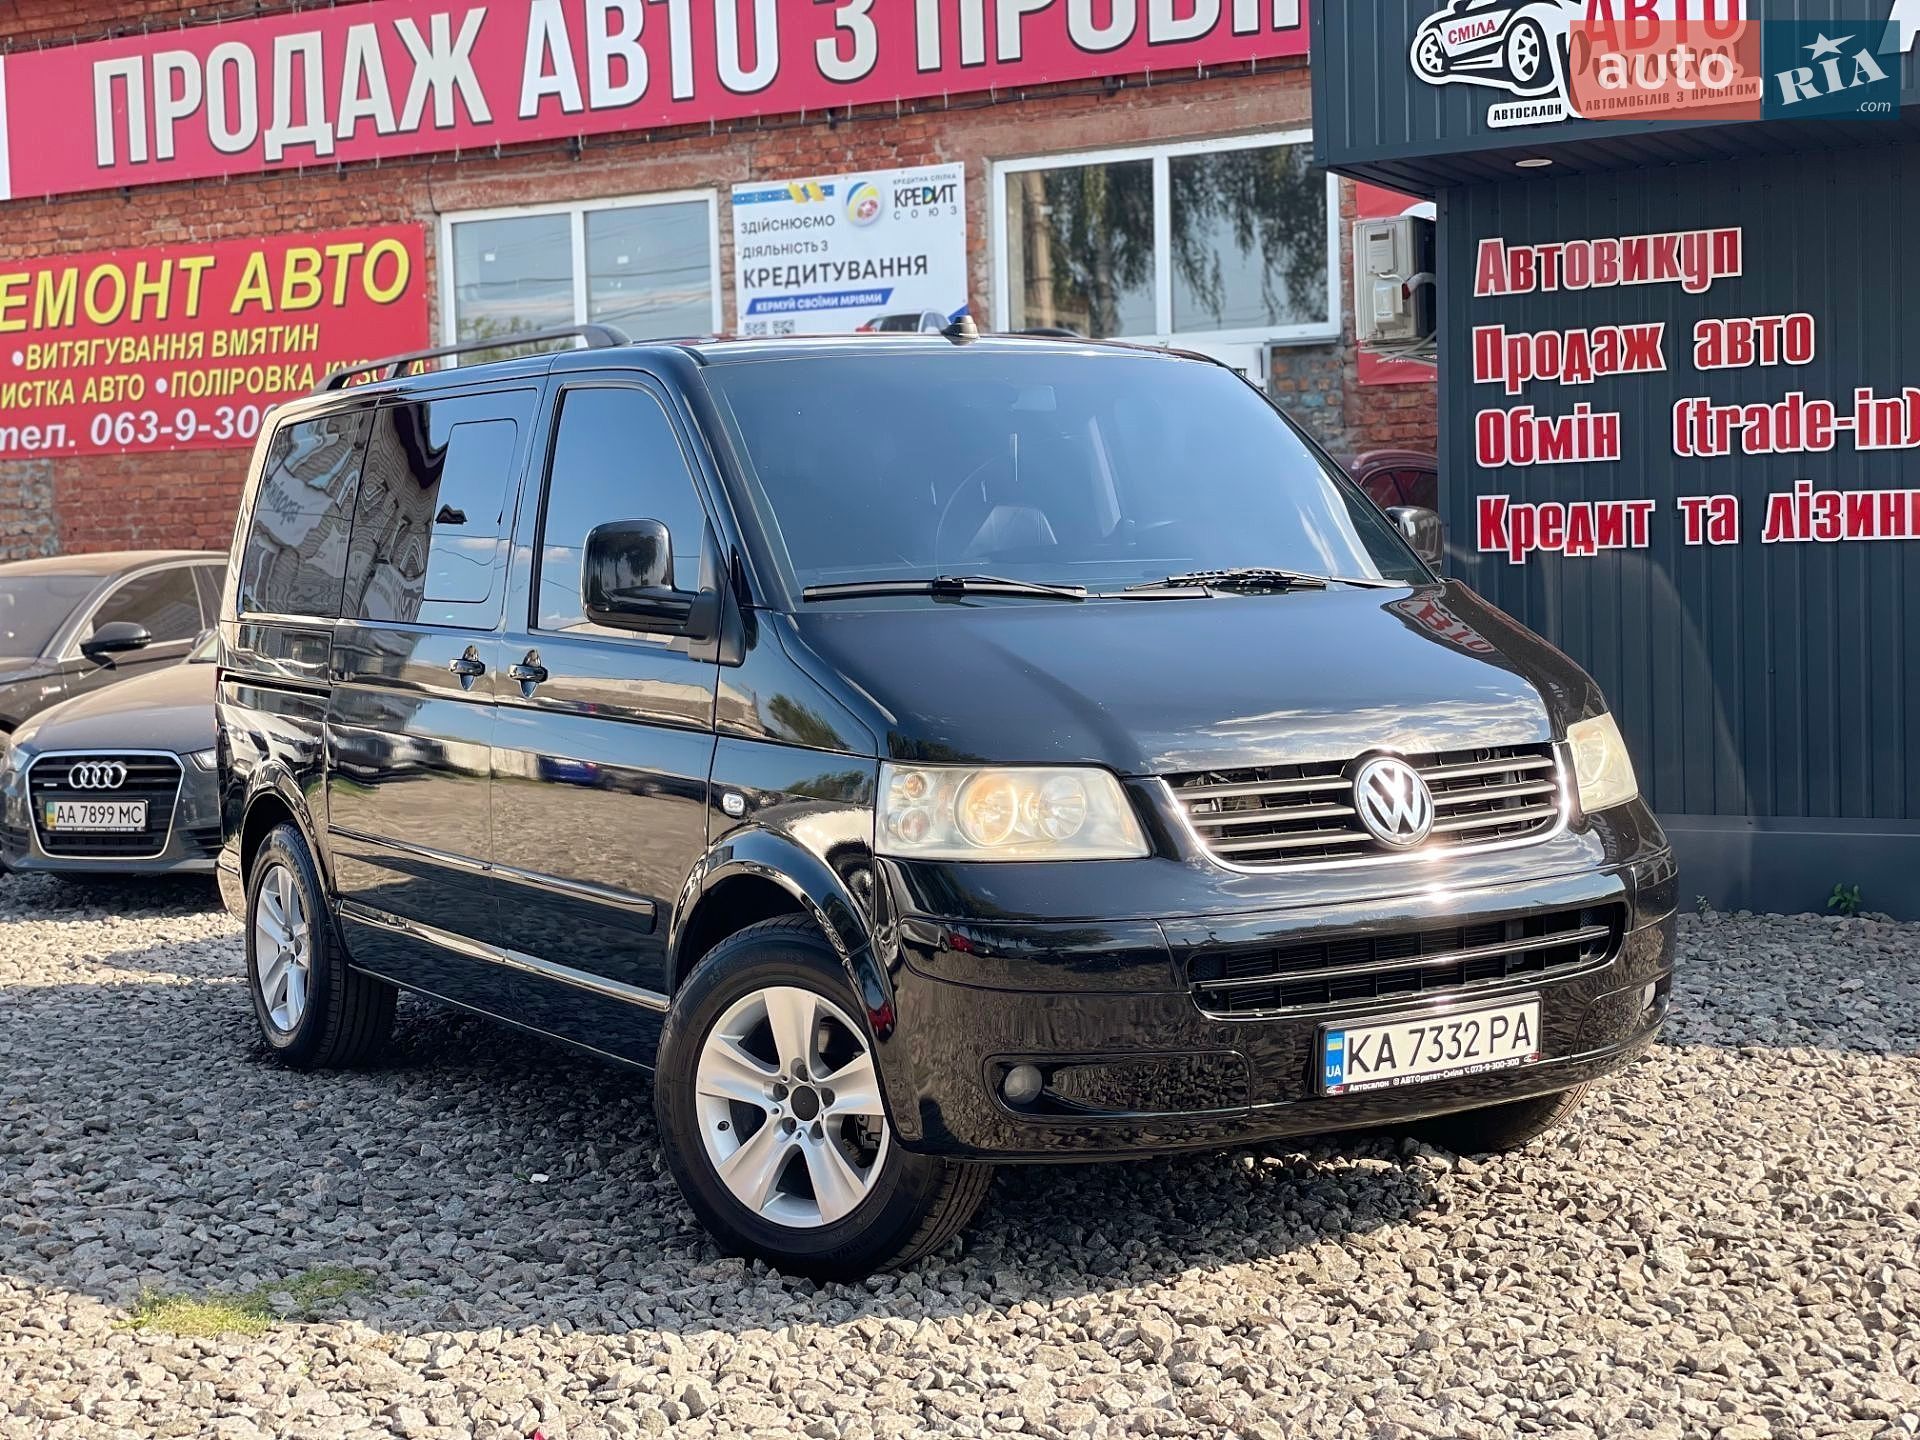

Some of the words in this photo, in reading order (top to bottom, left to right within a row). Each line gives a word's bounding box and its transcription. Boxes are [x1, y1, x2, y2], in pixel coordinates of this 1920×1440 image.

[1447, 20, 1496, 44] СМІЛА
[93, 8, 493, 167] ПРОДАЖ
[518, 0, 780, 119] АВТО
[1493, 104, 1562, 121] АВТОСАЛОН
[1585, 93, 1670, 111] АВТОМОБІЛІВ
[1676, 91, 1685, 103] З
[741, 214, 835, 234] ЗДІЙСНЮЄМО
[742, 242, 819, 259] ДІЯЛЬНІСТЬ
[821, 240, 829, 252] З
[1474, 227, 1742, 297] Автовикуп
[230, 238, 410, 313] АВТО
[743, 255, 928, 288] КРЕДИТУВАННЯ
[755, 299, 797, 311] КЕРМУЙ
[797, 295, 838, 309] СВОЇМИ
[839, 293, 882, 306] МРІЯМИ
[211, 323, 319, 358] ВМЯТИН
[1473, 322, 1667, 395] Продаж
[1693, 313, 1815, 369] авто
[82, 373, 145, 404] АВТО
[90, 404, 278, 446] 063-9-30
[1475, 403, 1620, 468] Обмін
[1673, 387, 1920, 458] (trade-in)
[1477, 495, 1655, 564] Кредит
[1677, 495, 1738, 545] та
[80, 805, 115, 824] 7899
[1408, 1020, 1481, 1067] 7332
[1326, 1065, 1342, 1078] UA
